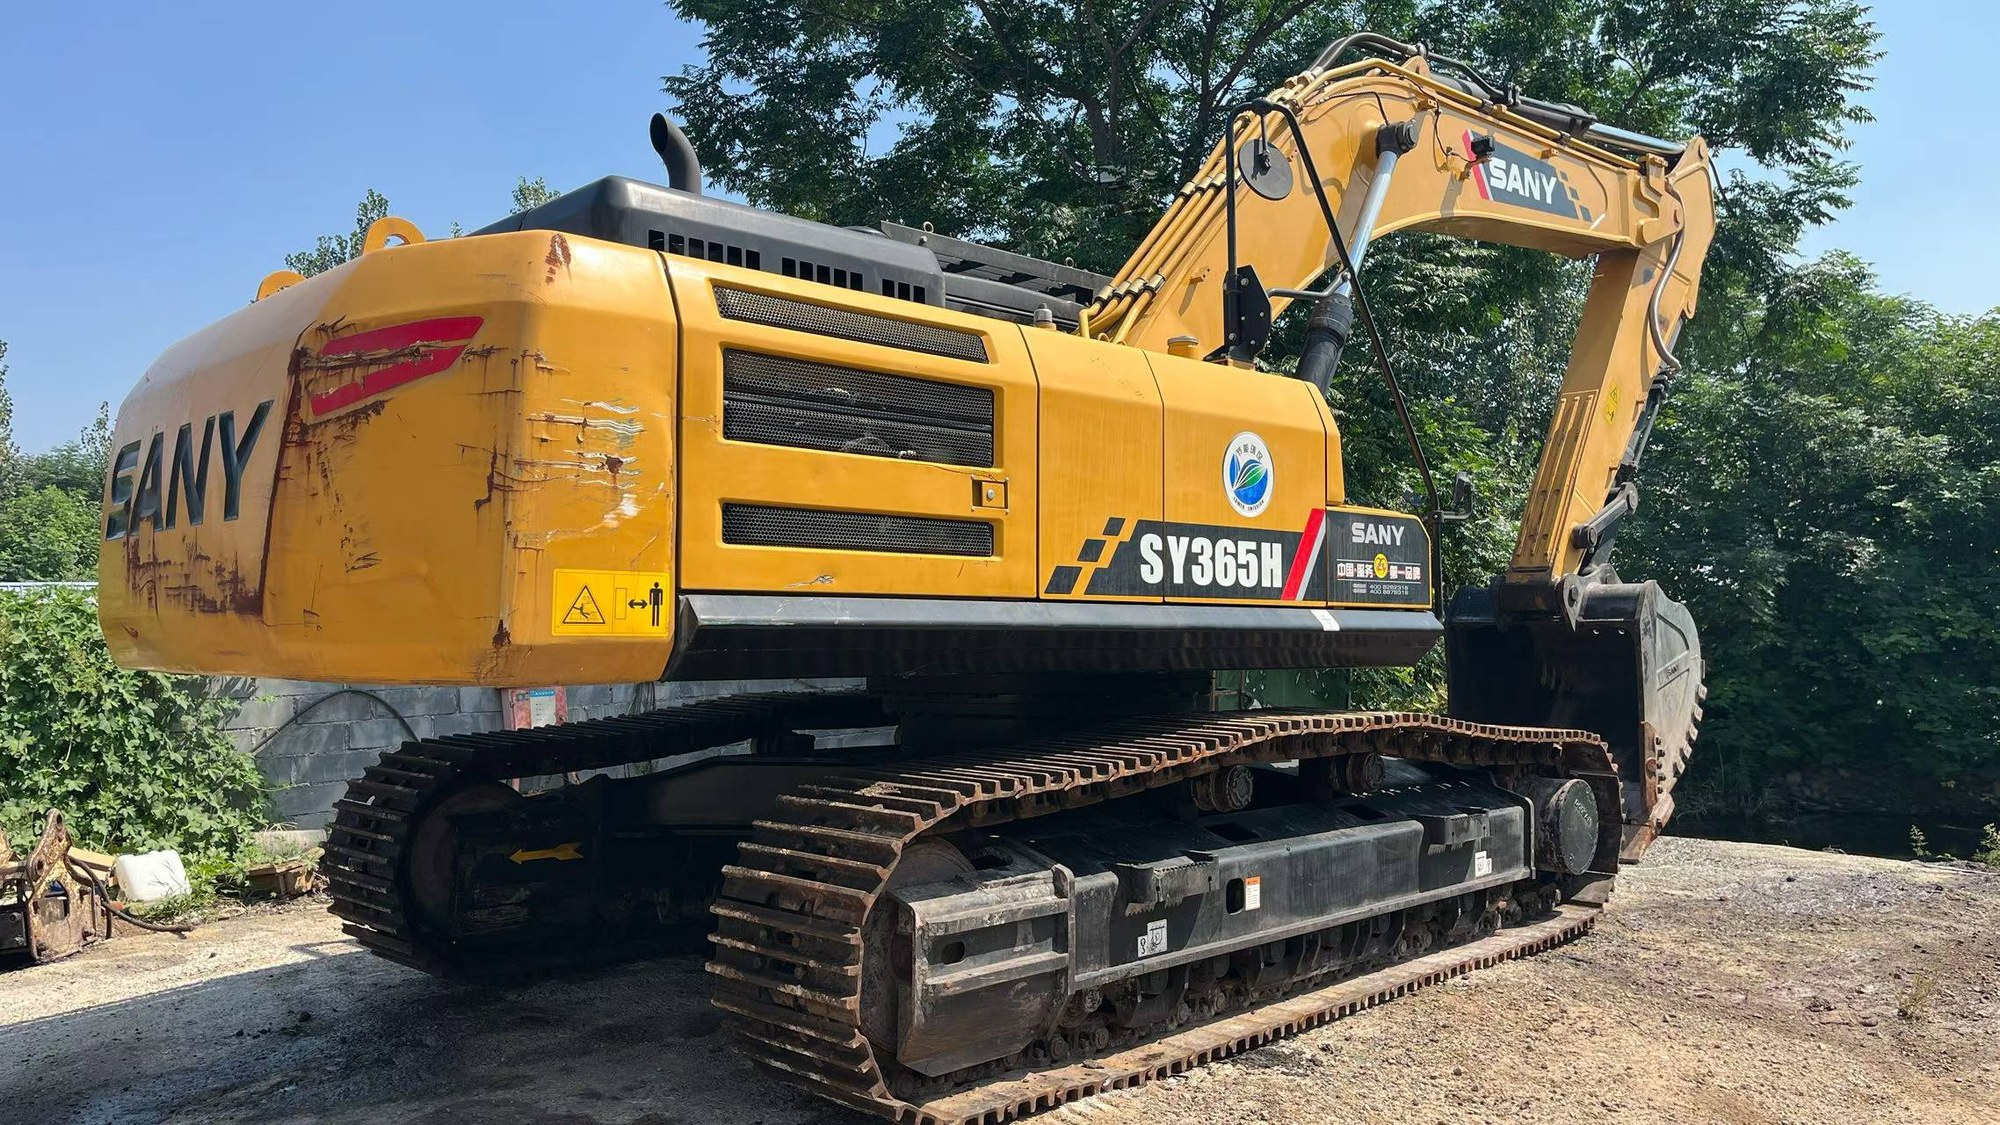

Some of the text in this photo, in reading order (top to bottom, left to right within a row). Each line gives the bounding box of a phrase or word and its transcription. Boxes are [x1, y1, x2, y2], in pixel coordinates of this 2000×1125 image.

[1489, 157, 1557, 205] SANY
[106, 400, 275, 541] SANY
[1351, 522, 1405, 546] SANY
[1140, 533, 1283, 588] SY365H
